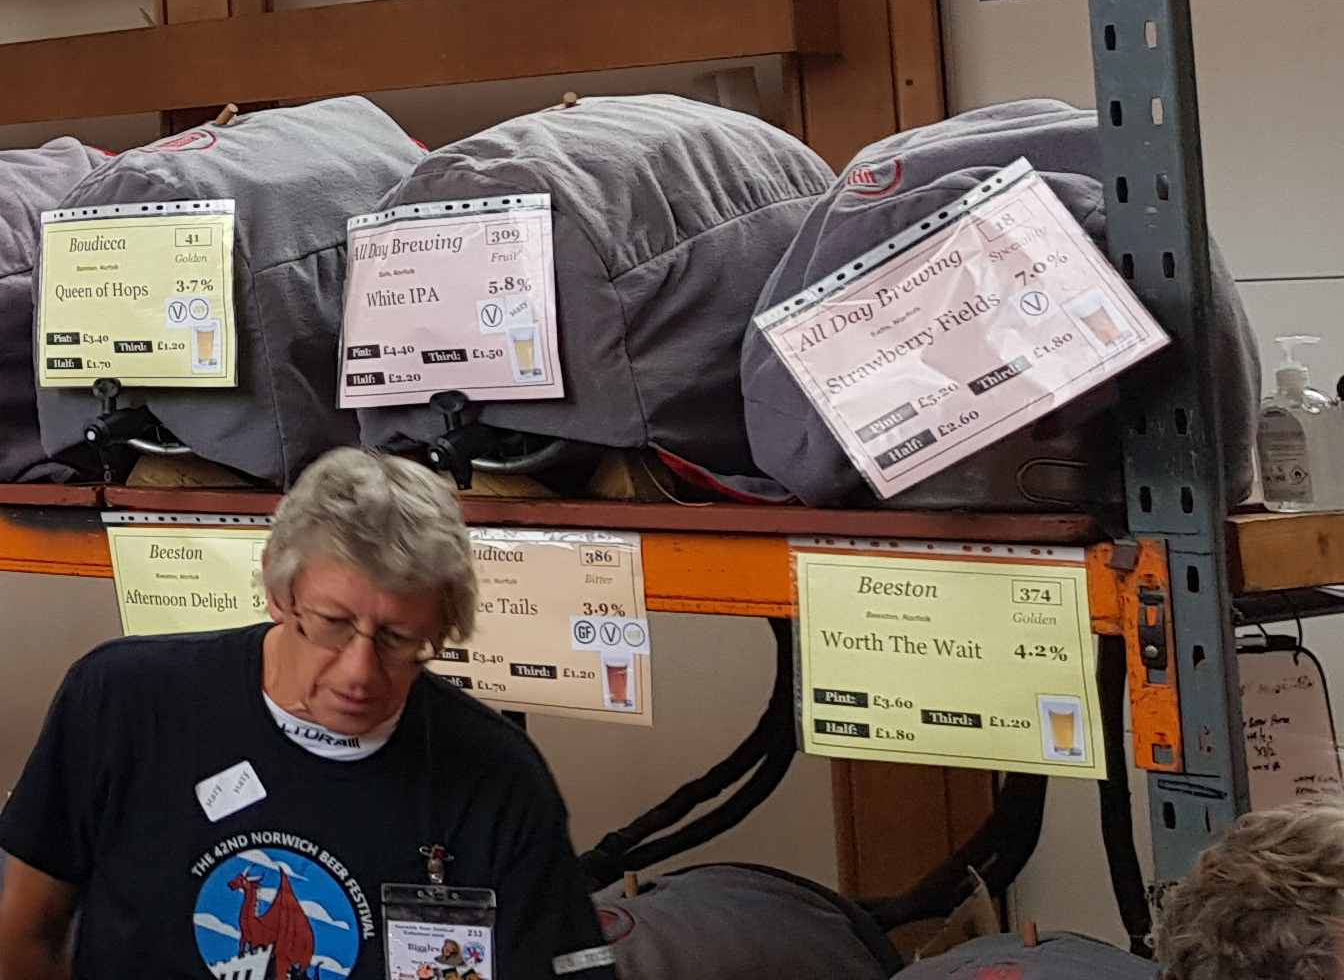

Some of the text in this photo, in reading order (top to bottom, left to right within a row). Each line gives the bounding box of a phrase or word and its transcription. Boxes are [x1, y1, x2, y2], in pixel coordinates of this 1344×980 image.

[996, 212, 1016, 232] 18
[185, 234, 200, 245] 41
[491, 229, 520, 243] 309
[69, 235, 126, 253] Boudicca
[368, 234, 463, 260] Day Brewing
[988, 225, 1050, 264] Speciality
[175, 253, 208, 263] Golden
[491, 250, 519, 262] Fruit
[55, 282, 149, 301] Queen of Hops
[176, 279, 214, 293] 3.7%
[488, 276, 532, 295] 5.8%
[366, 287, 440, 307] White IPA
[798, 248, 963, 354] All Day Brewing
[158, 342, 185, 351] £1.20
[383, 345, 415, 356] £4.40
[826, 291, 1001, 396] Strawberry Fields
[472, 348, 503, 359] £1.50
[86, 360, 111, 369] £1.70
[388, 373, 422, 383] £2.20
[869, 410, 904, 435] Pint:
[149, 544, 203, 560] Beeston
[473, 547, 524, 562] udicca
[585, 551, 612, 564] 386
[585, 574, 613, 584] Bitter
[857, 575, 939, 598] Beeston
[126, 589, 239, 612] Afternoon Delight
[1019, 587, 1052, 602] 374
[497, 598, 538, 615] Tails
[583, 602, 626, 617] 3.9%
[1012, 612, 1057, 626] Golden
[821, 630, 983, 660] Worth The Wait
[1014, 643, 1068, 661] 4.2%
[563, 668, 596, 680] £1.20
[477, 682, 506, 692] £1.70
[825, 691, 913, 709] Pint: £3.60
[989, 716, 1031, 730] £1.20
[825, 722, 915, 742] Half: £1.80
[191, 831, 375, 941] THE 42ND NORWICH BEER FESTIVAL
